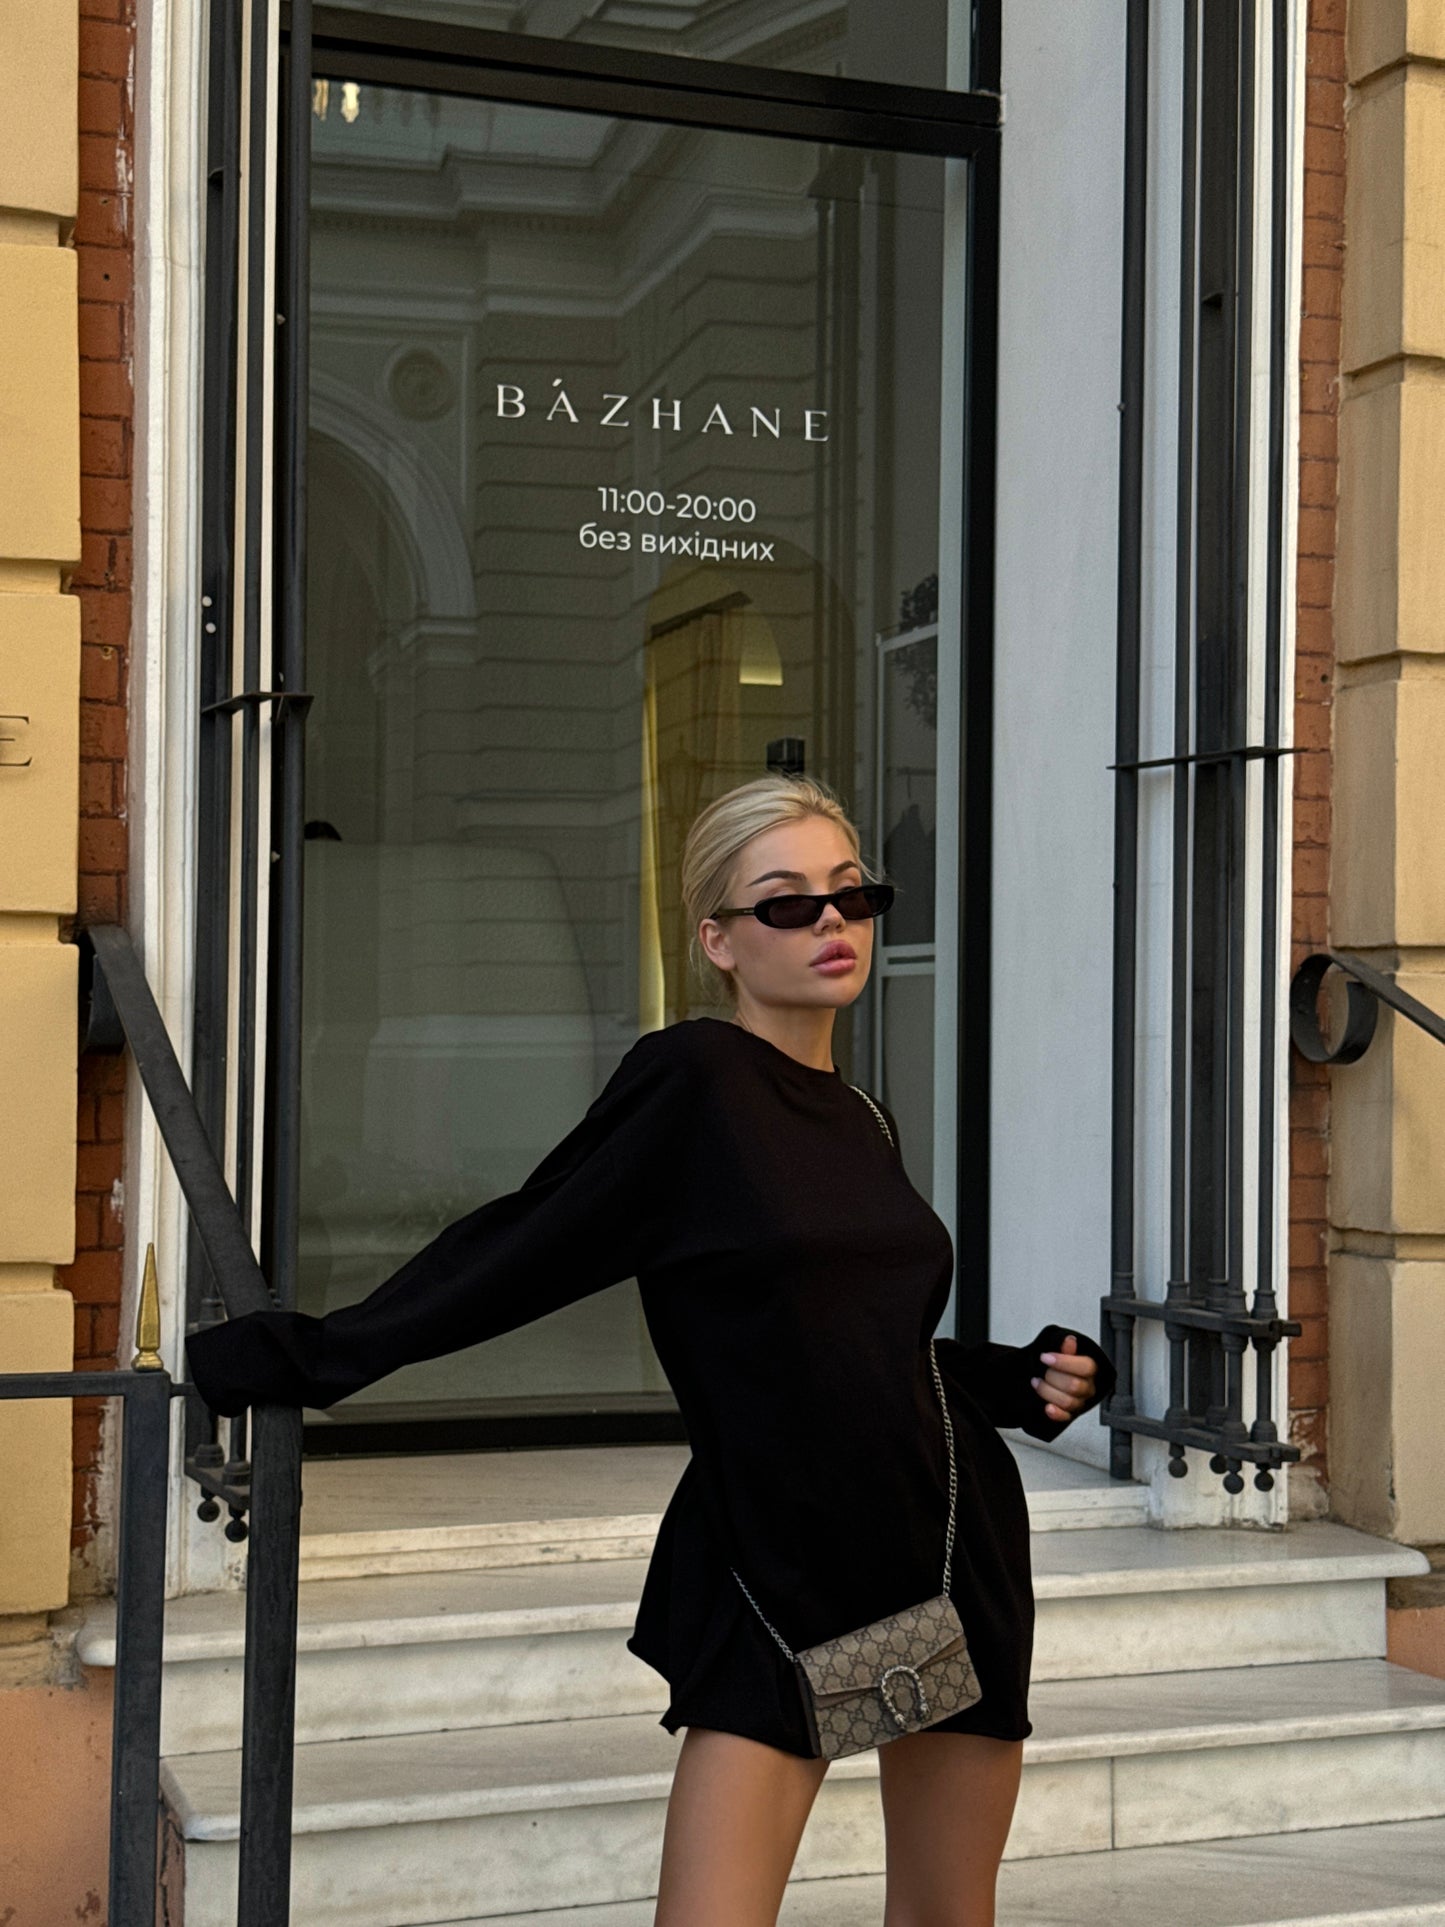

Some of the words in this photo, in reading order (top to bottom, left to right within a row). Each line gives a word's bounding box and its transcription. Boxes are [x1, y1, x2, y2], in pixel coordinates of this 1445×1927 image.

[496, 378, 829, 442] BÁZHANE
[598, 486, 757, 523] 11:00-20:00
[578, 522, 632, 551] без
[641, 531, 775, 562] вихідних
